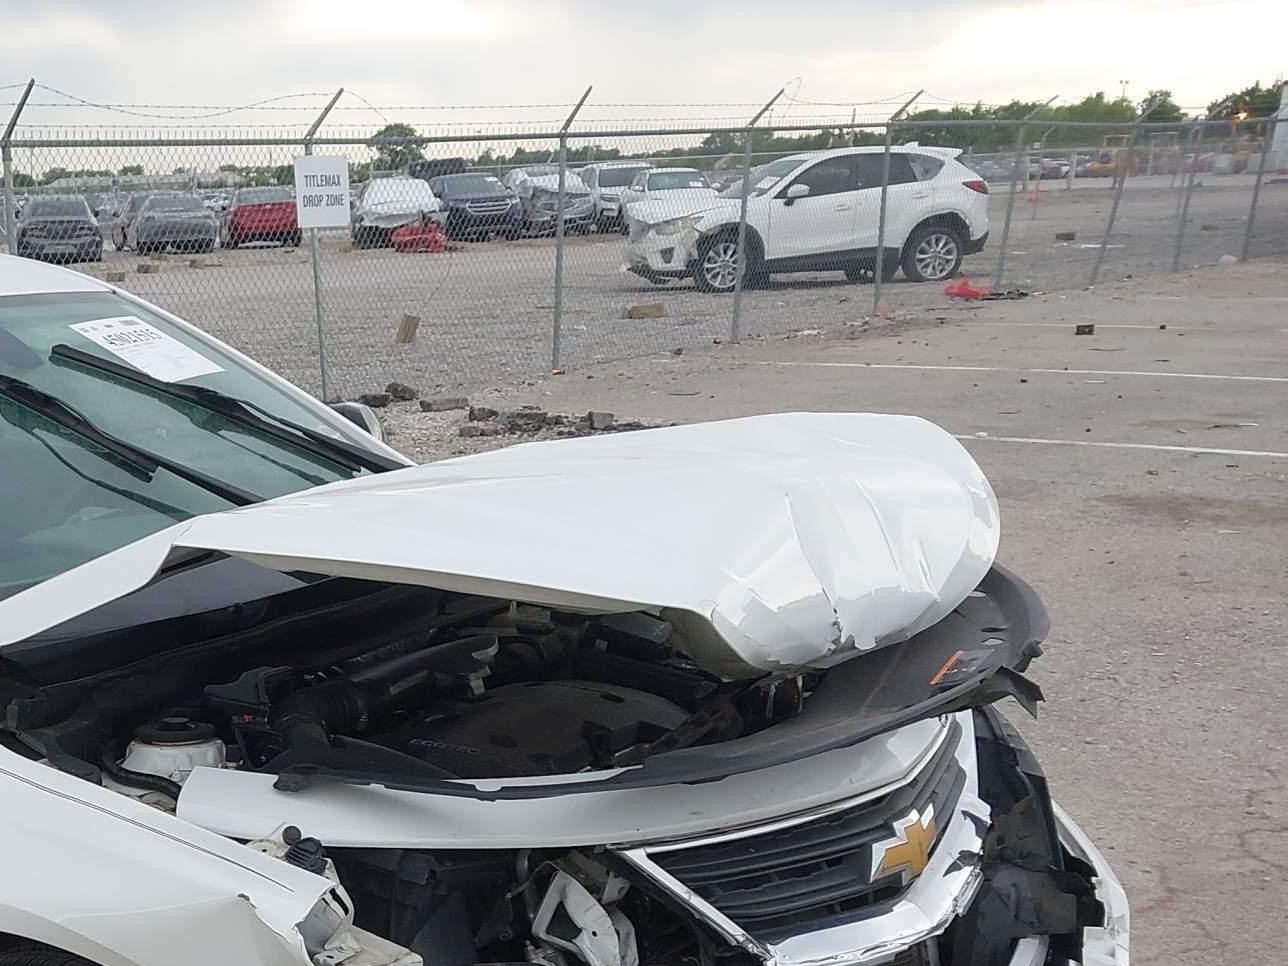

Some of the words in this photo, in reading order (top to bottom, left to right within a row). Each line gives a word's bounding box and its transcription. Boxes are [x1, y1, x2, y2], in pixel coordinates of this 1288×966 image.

[304, 174, 341, 188] TITLEMAX
[303, 194, 324, 208] DROP
[325, 193, 345, 207] ZONE
[102, 328, 162, 347] 45021515
